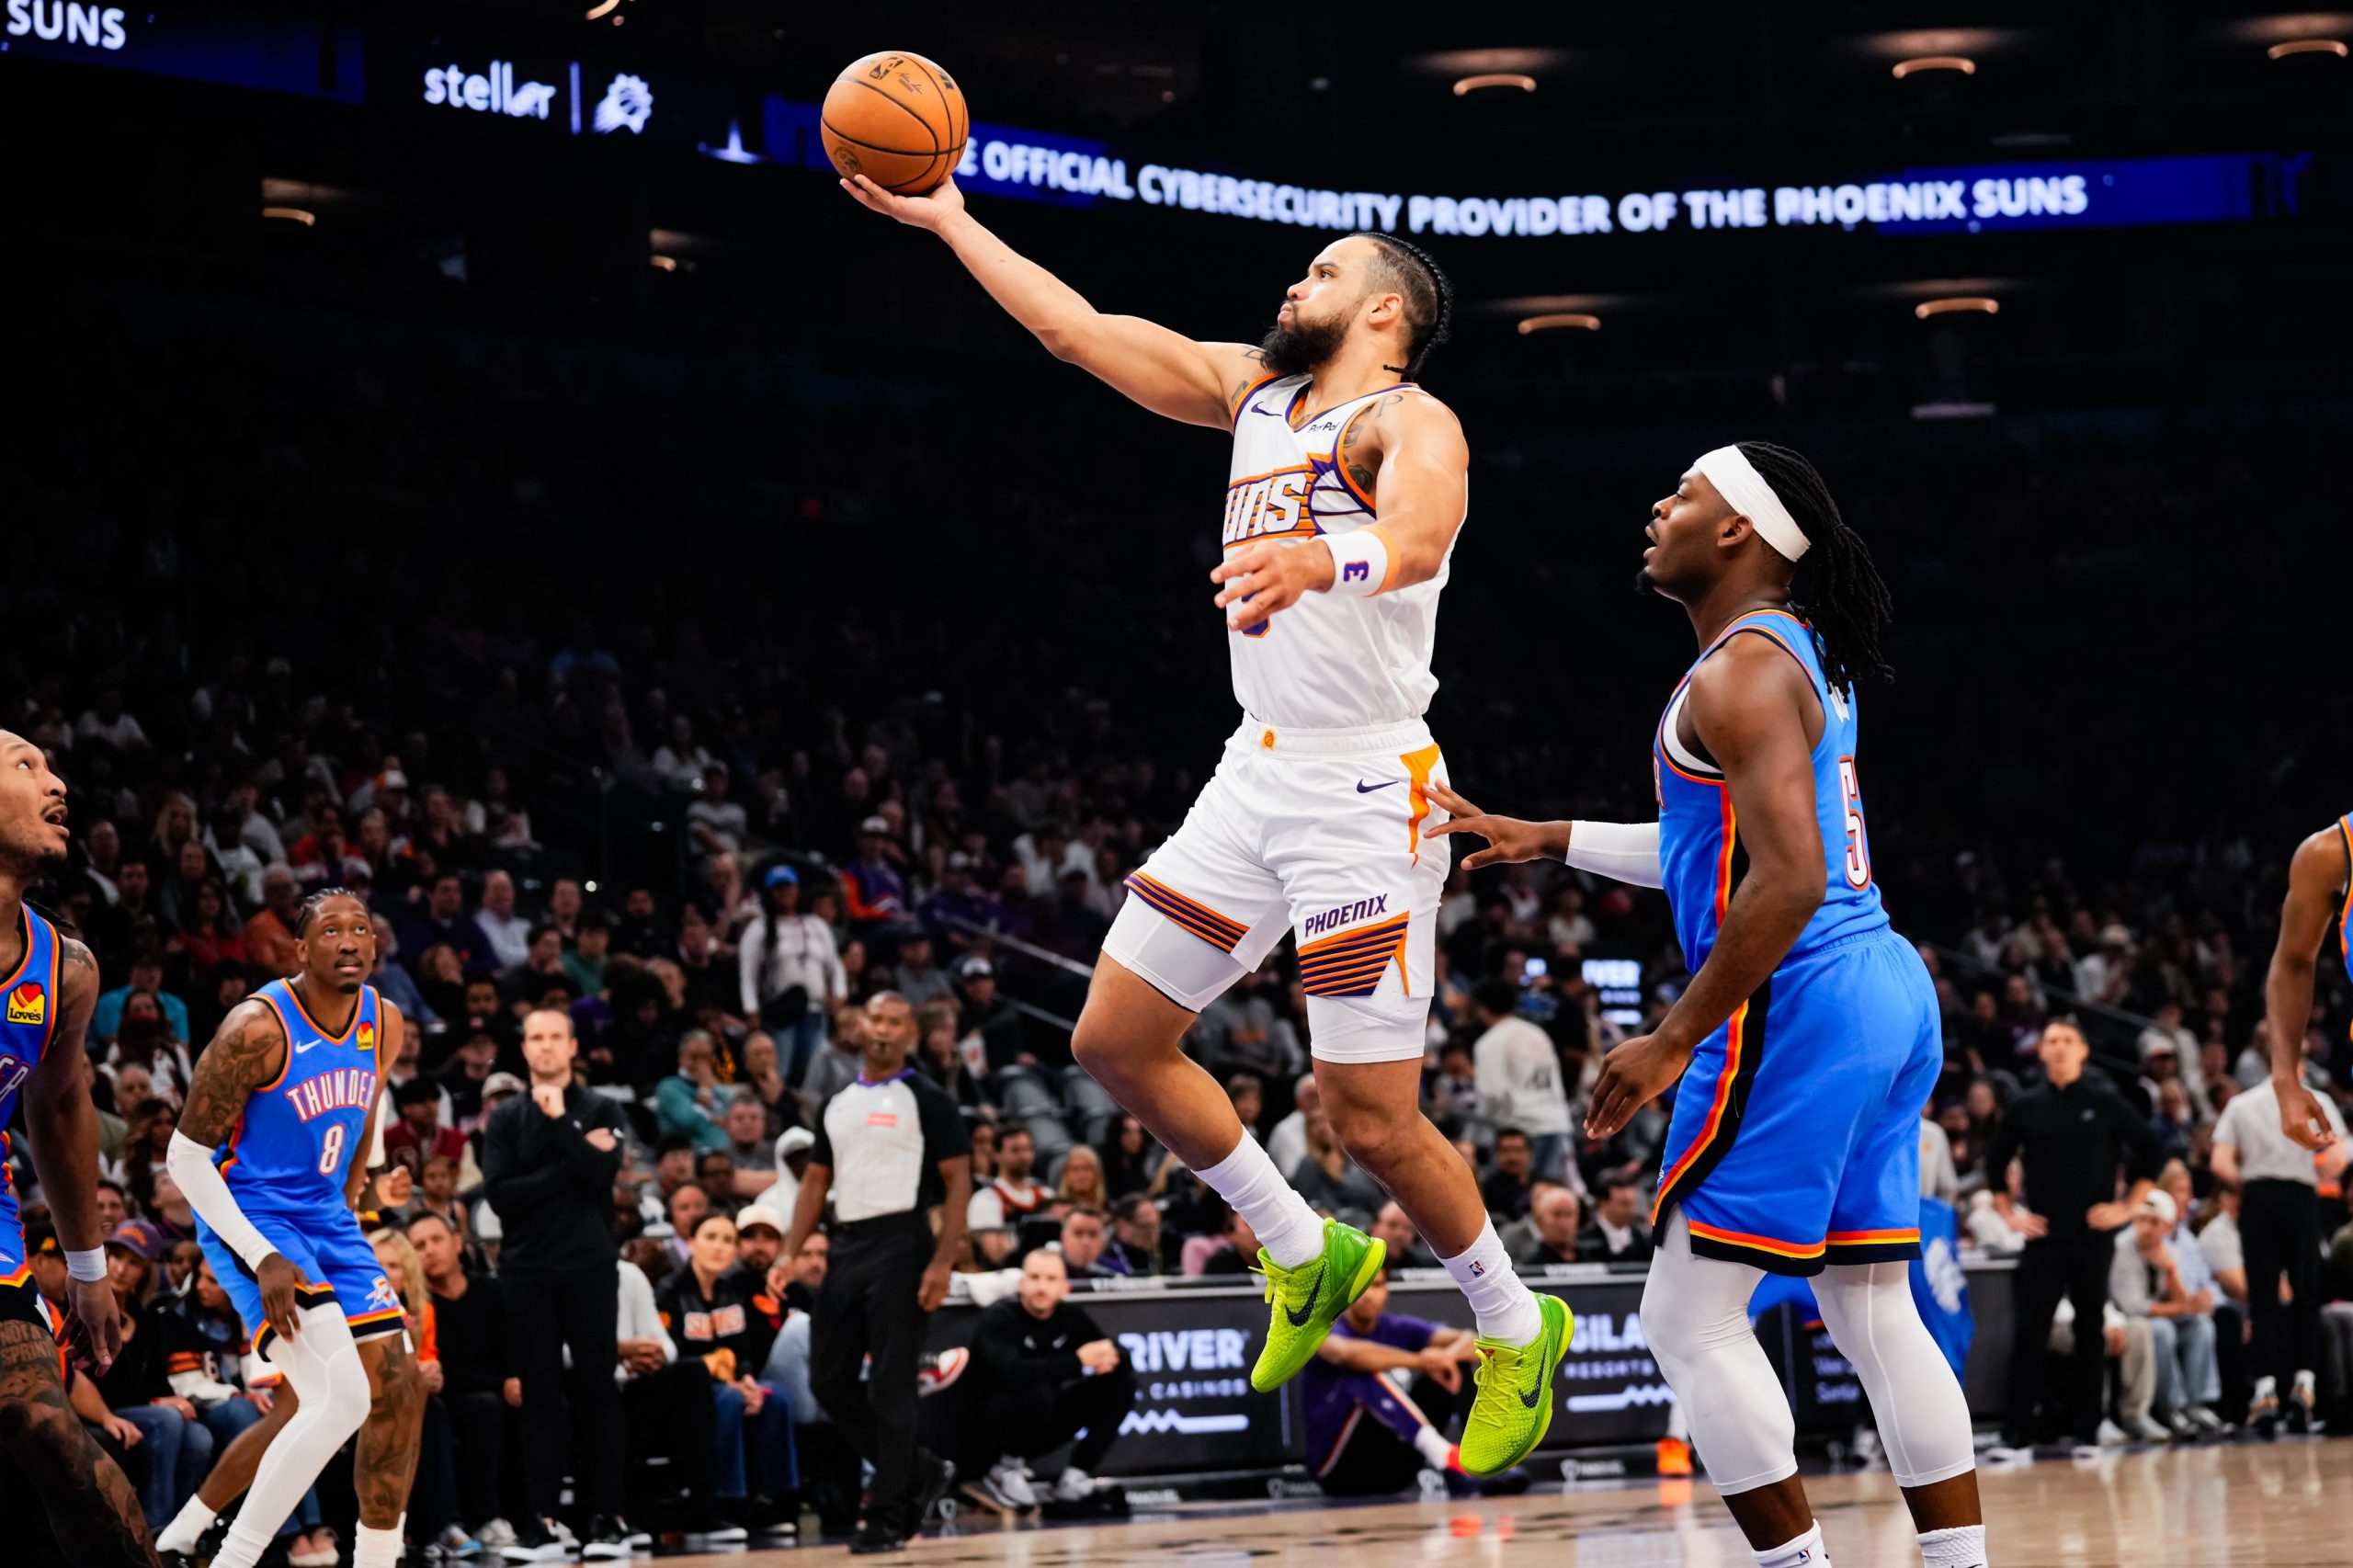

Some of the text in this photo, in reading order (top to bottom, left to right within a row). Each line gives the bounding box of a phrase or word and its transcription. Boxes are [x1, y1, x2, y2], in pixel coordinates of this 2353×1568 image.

[6, 0, 126, 50] SUNS
[425, 61, 556, 119] stellar
[983, 141, 1135, 199] OFFICIAL
[1137, 164, 1402, 233] CYBERSECURITY
[1408, 195, 1612, 237] PROVIDER
[1618, 193, 1677, 233] OF
[1682, 188, 1767, 229] THE
[1774, 181, 1967, 226] PHOENIX
[1972, 176, 2088, 219] SUNS
[1222, 472, 1309, 546] UNS
[1343, 559, 1370, 583] 3
[1838, 755, 1871, 892] 5
[1305, 892, 1388, 937] PHOENIX
[318, 1123, 345, 1176] 8
[1118, 1329, 1245, 1372] RIVER
[1149, 1378, 1248, 1401] CASINOS
